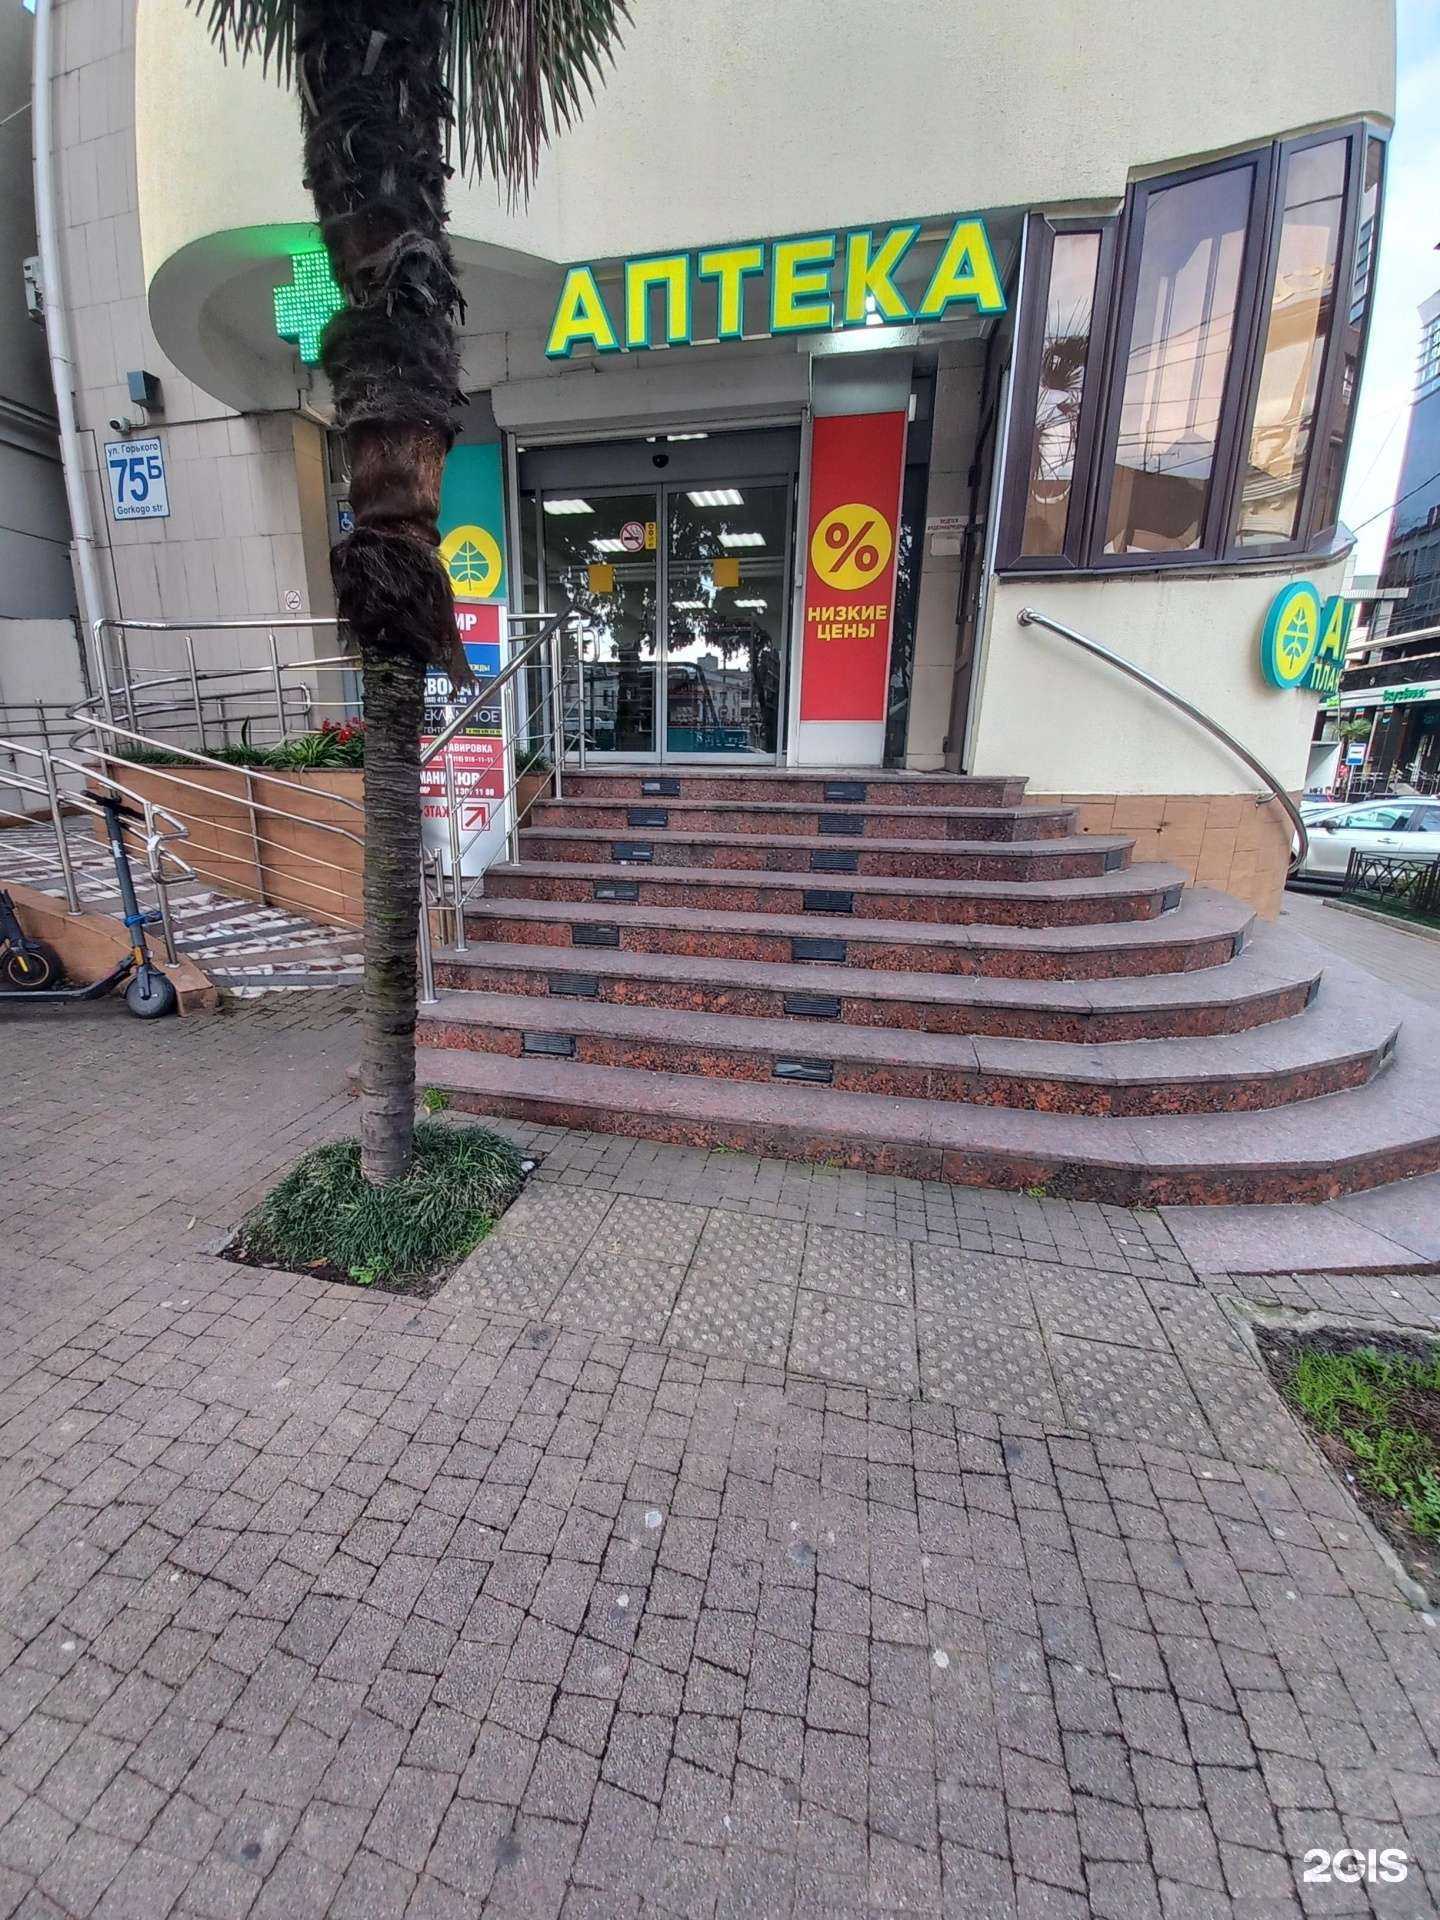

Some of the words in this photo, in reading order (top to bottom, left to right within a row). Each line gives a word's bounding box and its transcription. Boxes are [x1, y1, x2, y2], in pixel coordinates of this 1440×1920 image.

[545, 215, 1008, 360] АПТЕКА
[121, 443, 158, 454] Горького
[117, 505, 150, 515] Gorkogo
[454, 613, 478, 631] ИР
[808, 605, 888, 622] НИЗКИЕ
[817, 623, 876, 641] ЦЕНЫ
[424, 708, 500, 723] ЕКЛАНОЕ
